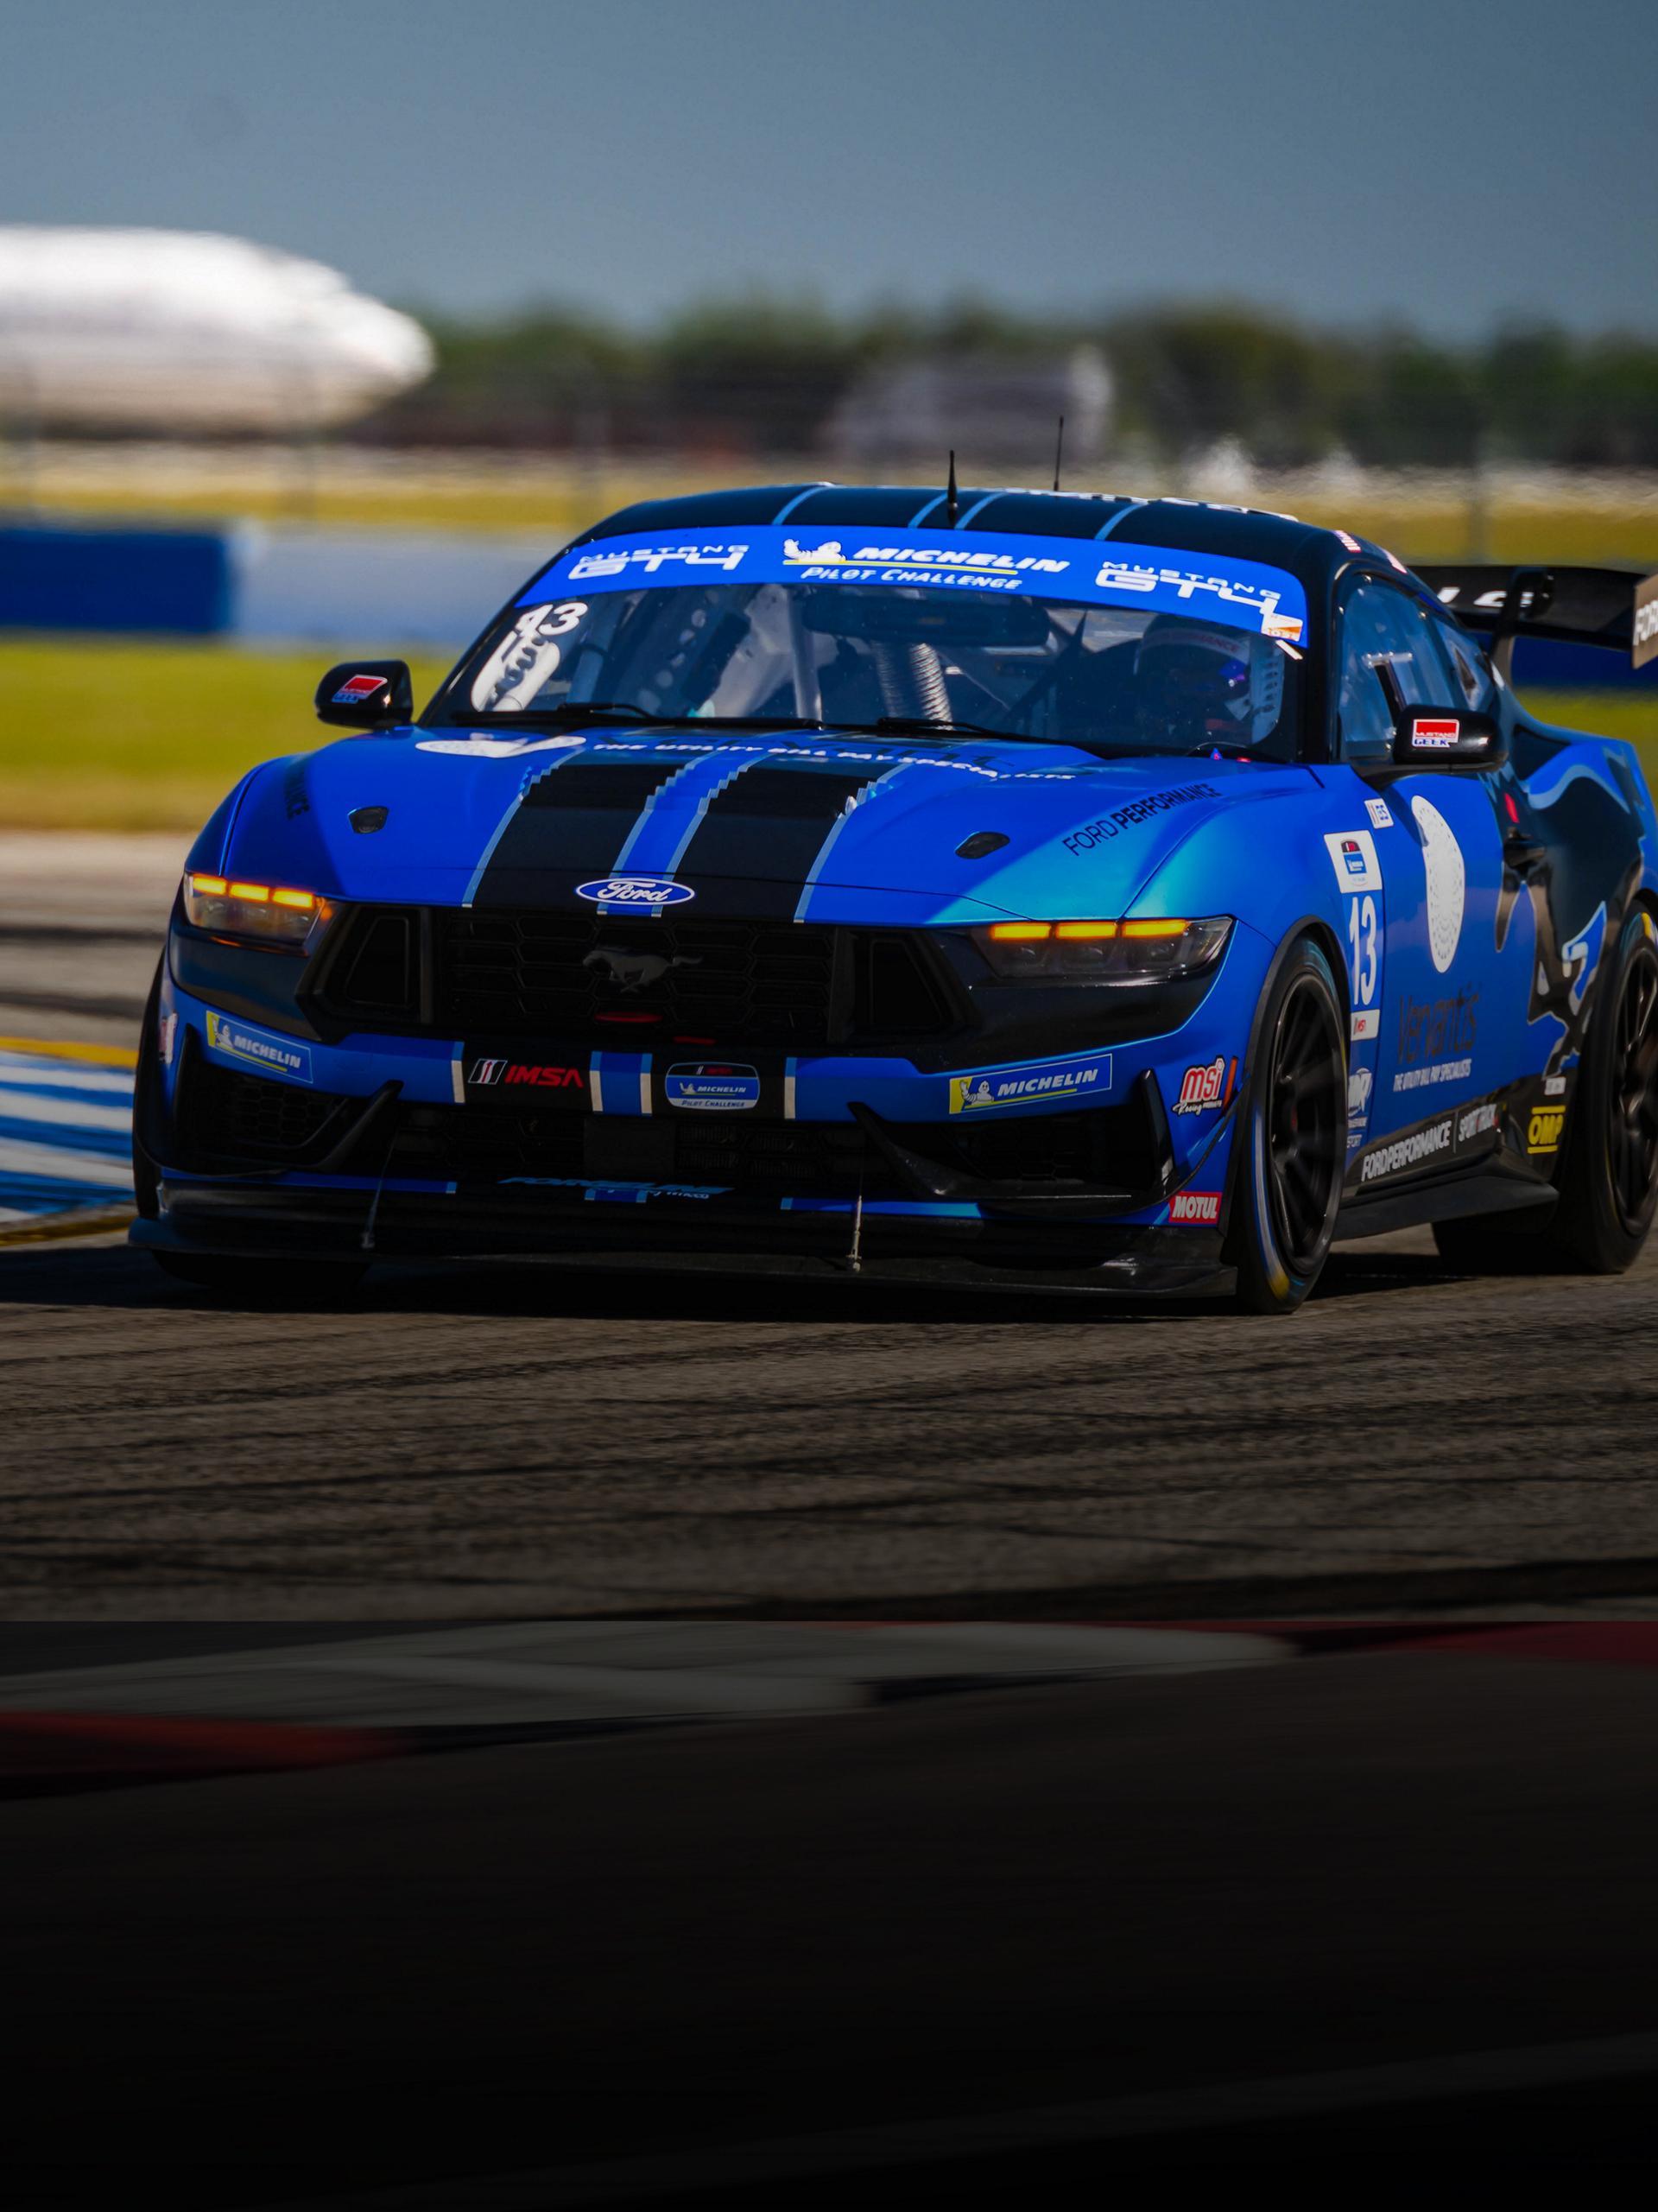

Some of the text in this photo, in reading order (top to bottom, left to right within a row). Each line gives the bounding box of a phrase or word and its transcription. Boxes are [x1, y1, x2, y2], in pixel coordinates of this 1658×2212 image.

[852, 547, 1070, 573] MICHELIN
[801, 567, 1022, 590] PILOT CHALLENGE
[1102, 561, 1281, 600] MUSTANG
[1063, 783, 1222, 856] FORD PERFORMANCE
[596, 880, 674, 903] Ford
[1349, 895, 1378, 1005] 13
[233, 1034, 301, 1068] MICHELIN
[504, 1065, 585, 1087] IMSA
[697, 1085, 747, 1093] MICHELIN
[997, 1068, 1098, 1097] MICHELIN
[704, 1100, 745, 1108] CHALLENGE
[1528, 1114, 1564, 1145] OMP
[1171, 1196, 1218, 1219] MOTUL
